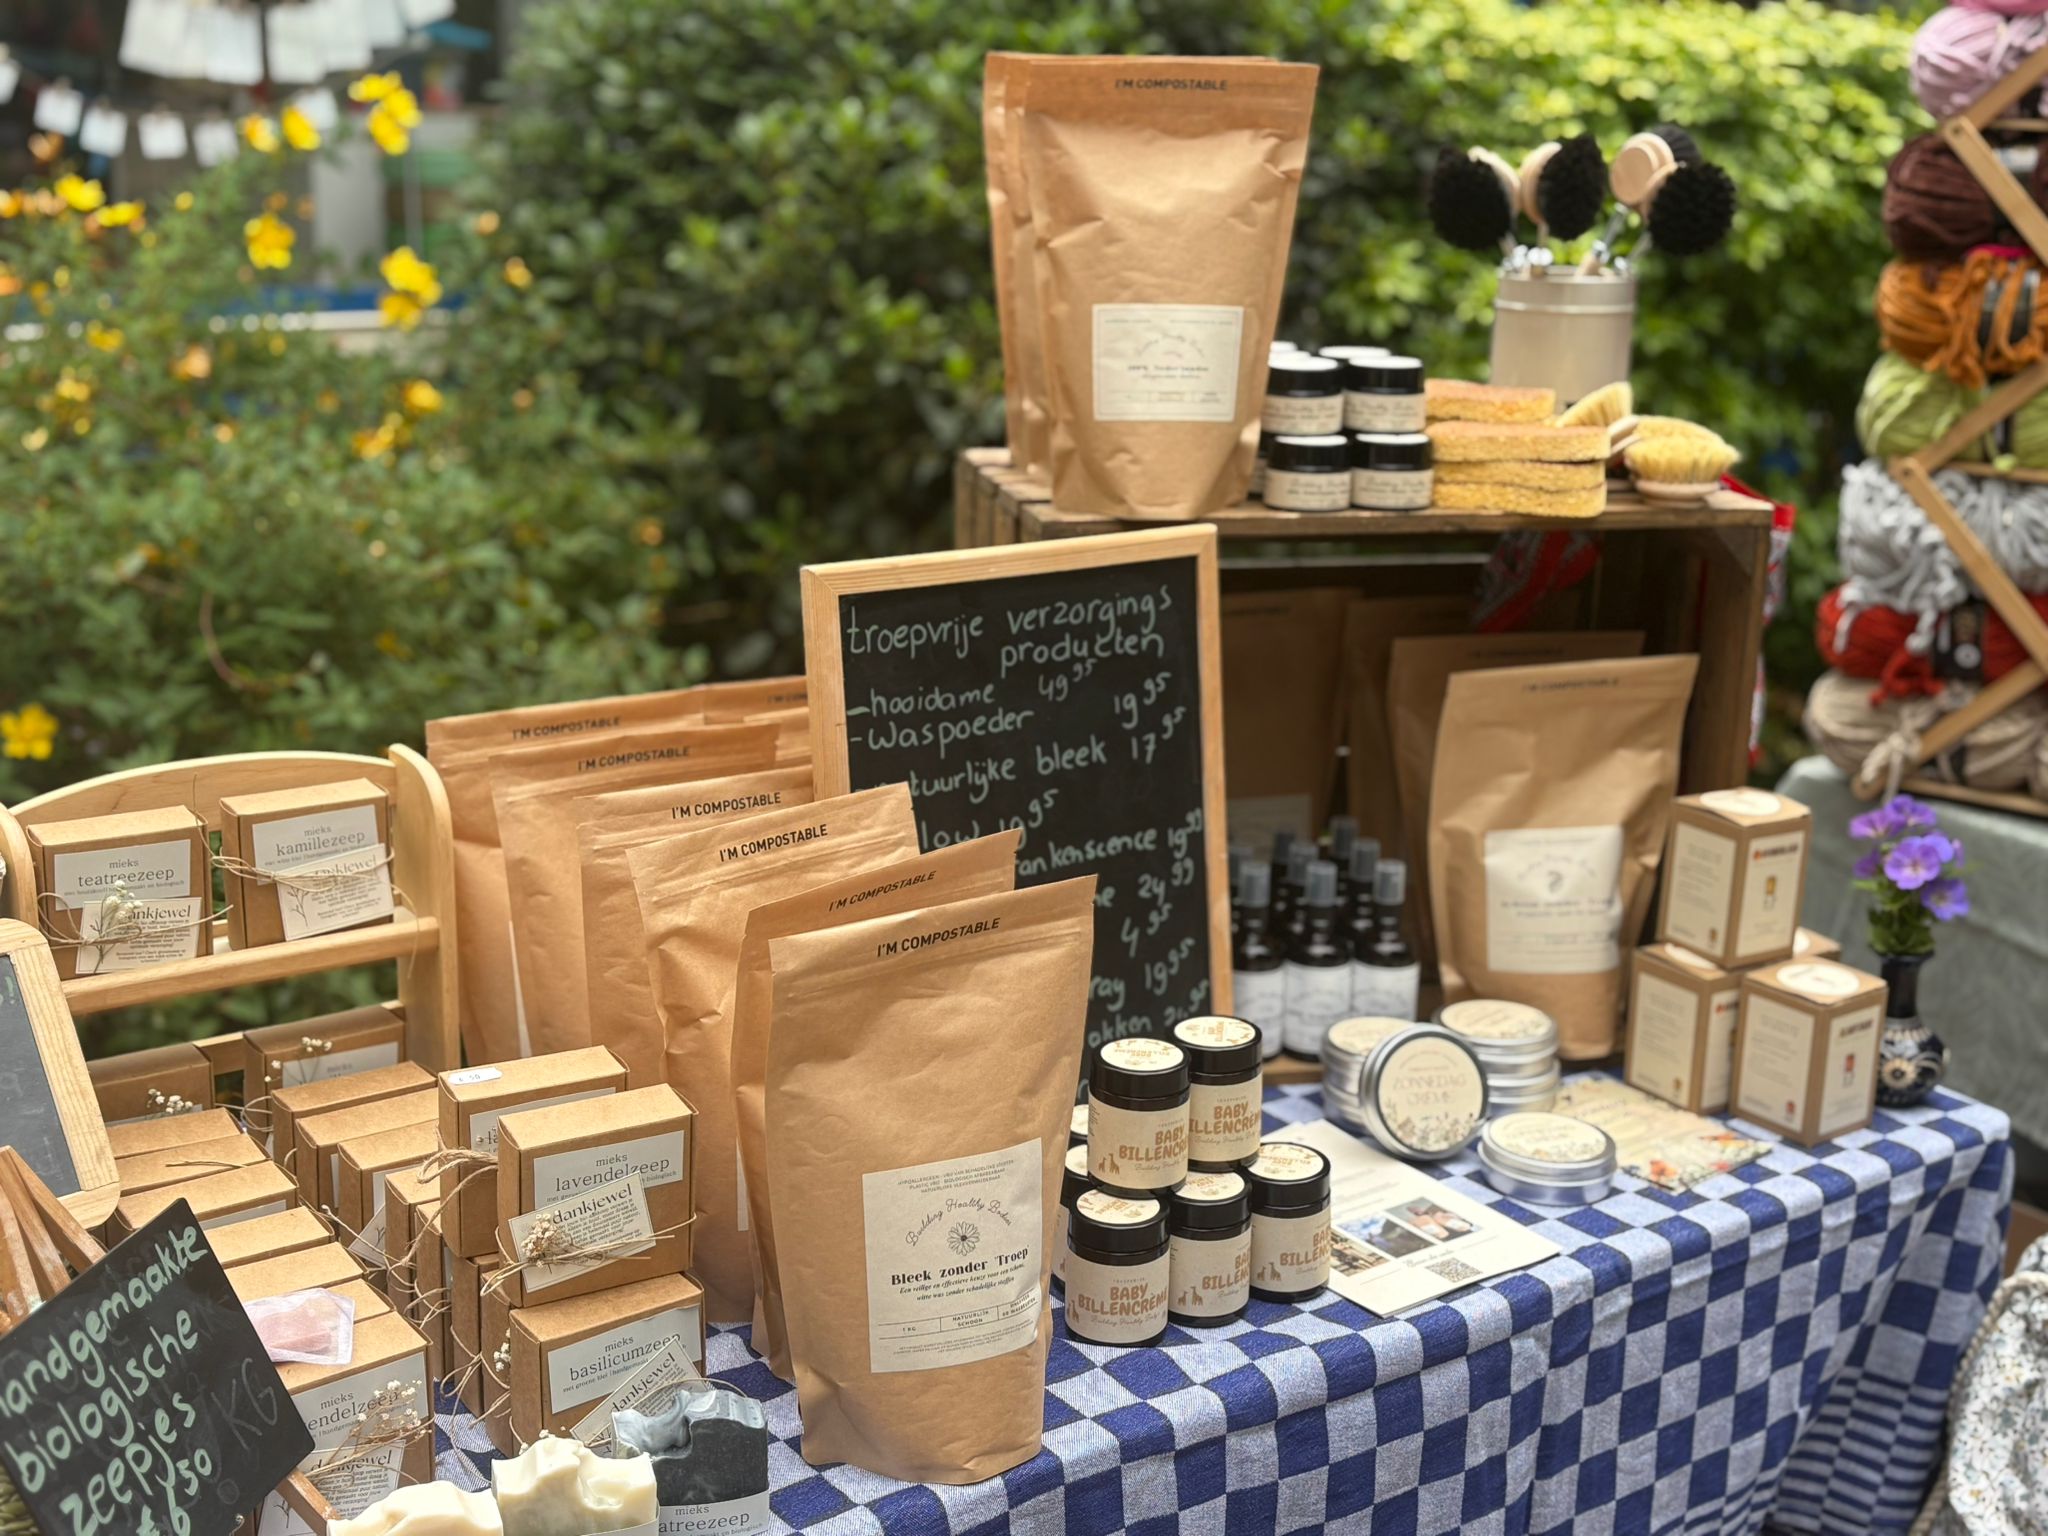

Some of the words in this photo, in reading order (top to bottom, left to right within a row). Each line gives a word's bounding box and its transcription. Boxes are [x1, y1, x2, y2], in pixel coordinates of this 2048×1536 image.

[1115, 79, 1133, 89] I'M
[1137, 79, 1228, 91] COMPOSTABLE
[847, 606, 984, 659] troepvrije
[1007, 585, 1172, 640] verzorgings
[512, 727, 530, 740] I'M
[534, 716, 621, 737] COMPOSTABLE
[577, 759, 596, 772] I'M
[599, 746, 690, 768] COMPOSTABLE
[1036, 735, 1107, 776] bleek
[672, 805, 691, 819] I'M
[695, 792, 781, 816] COMPOSTABLE
[304, 825, 332, 837] mieks
[276, 831, 366, 857] kamillezeep
[719, 847, 738, 862] I'M
[741, 824, 828, 856] COMPOSTABLE
[109, 858, 139, 869] mieks
[78, 868, 175, 888] teatreezeep
[828, 898, 848, 913] I'M
[849, 870, 937, 905] COMPOSTABLE
[127, 904, 191, 921] ankjewel
[876, 943, 897, 958] I'M
[901, 917, 1000, 951] COMPOSTABLE
[1213, 1101, 1249, 1120] BABY
[1155, 1124, 1185, 1146] BABY
[595, 1152, 628, 1167] mieks
[555, 1158, 670, 1193] lavendelzeep
[552, 1182, 633, 1225] dankjewel
[945, 1197, 985, 1213] Healthy
[891, 1269, 932, 1286] Bleek
[939, 1260, 989, 1278] zonder
[1109, 1282, 1149, 1301] BABY
[605, 1336, 635, 1353] mieks
[4, 1309, 200, 1494] biologische
[320, 1391, 354, 1410] mieks
[675, 1505, 710, 1516] mieks
